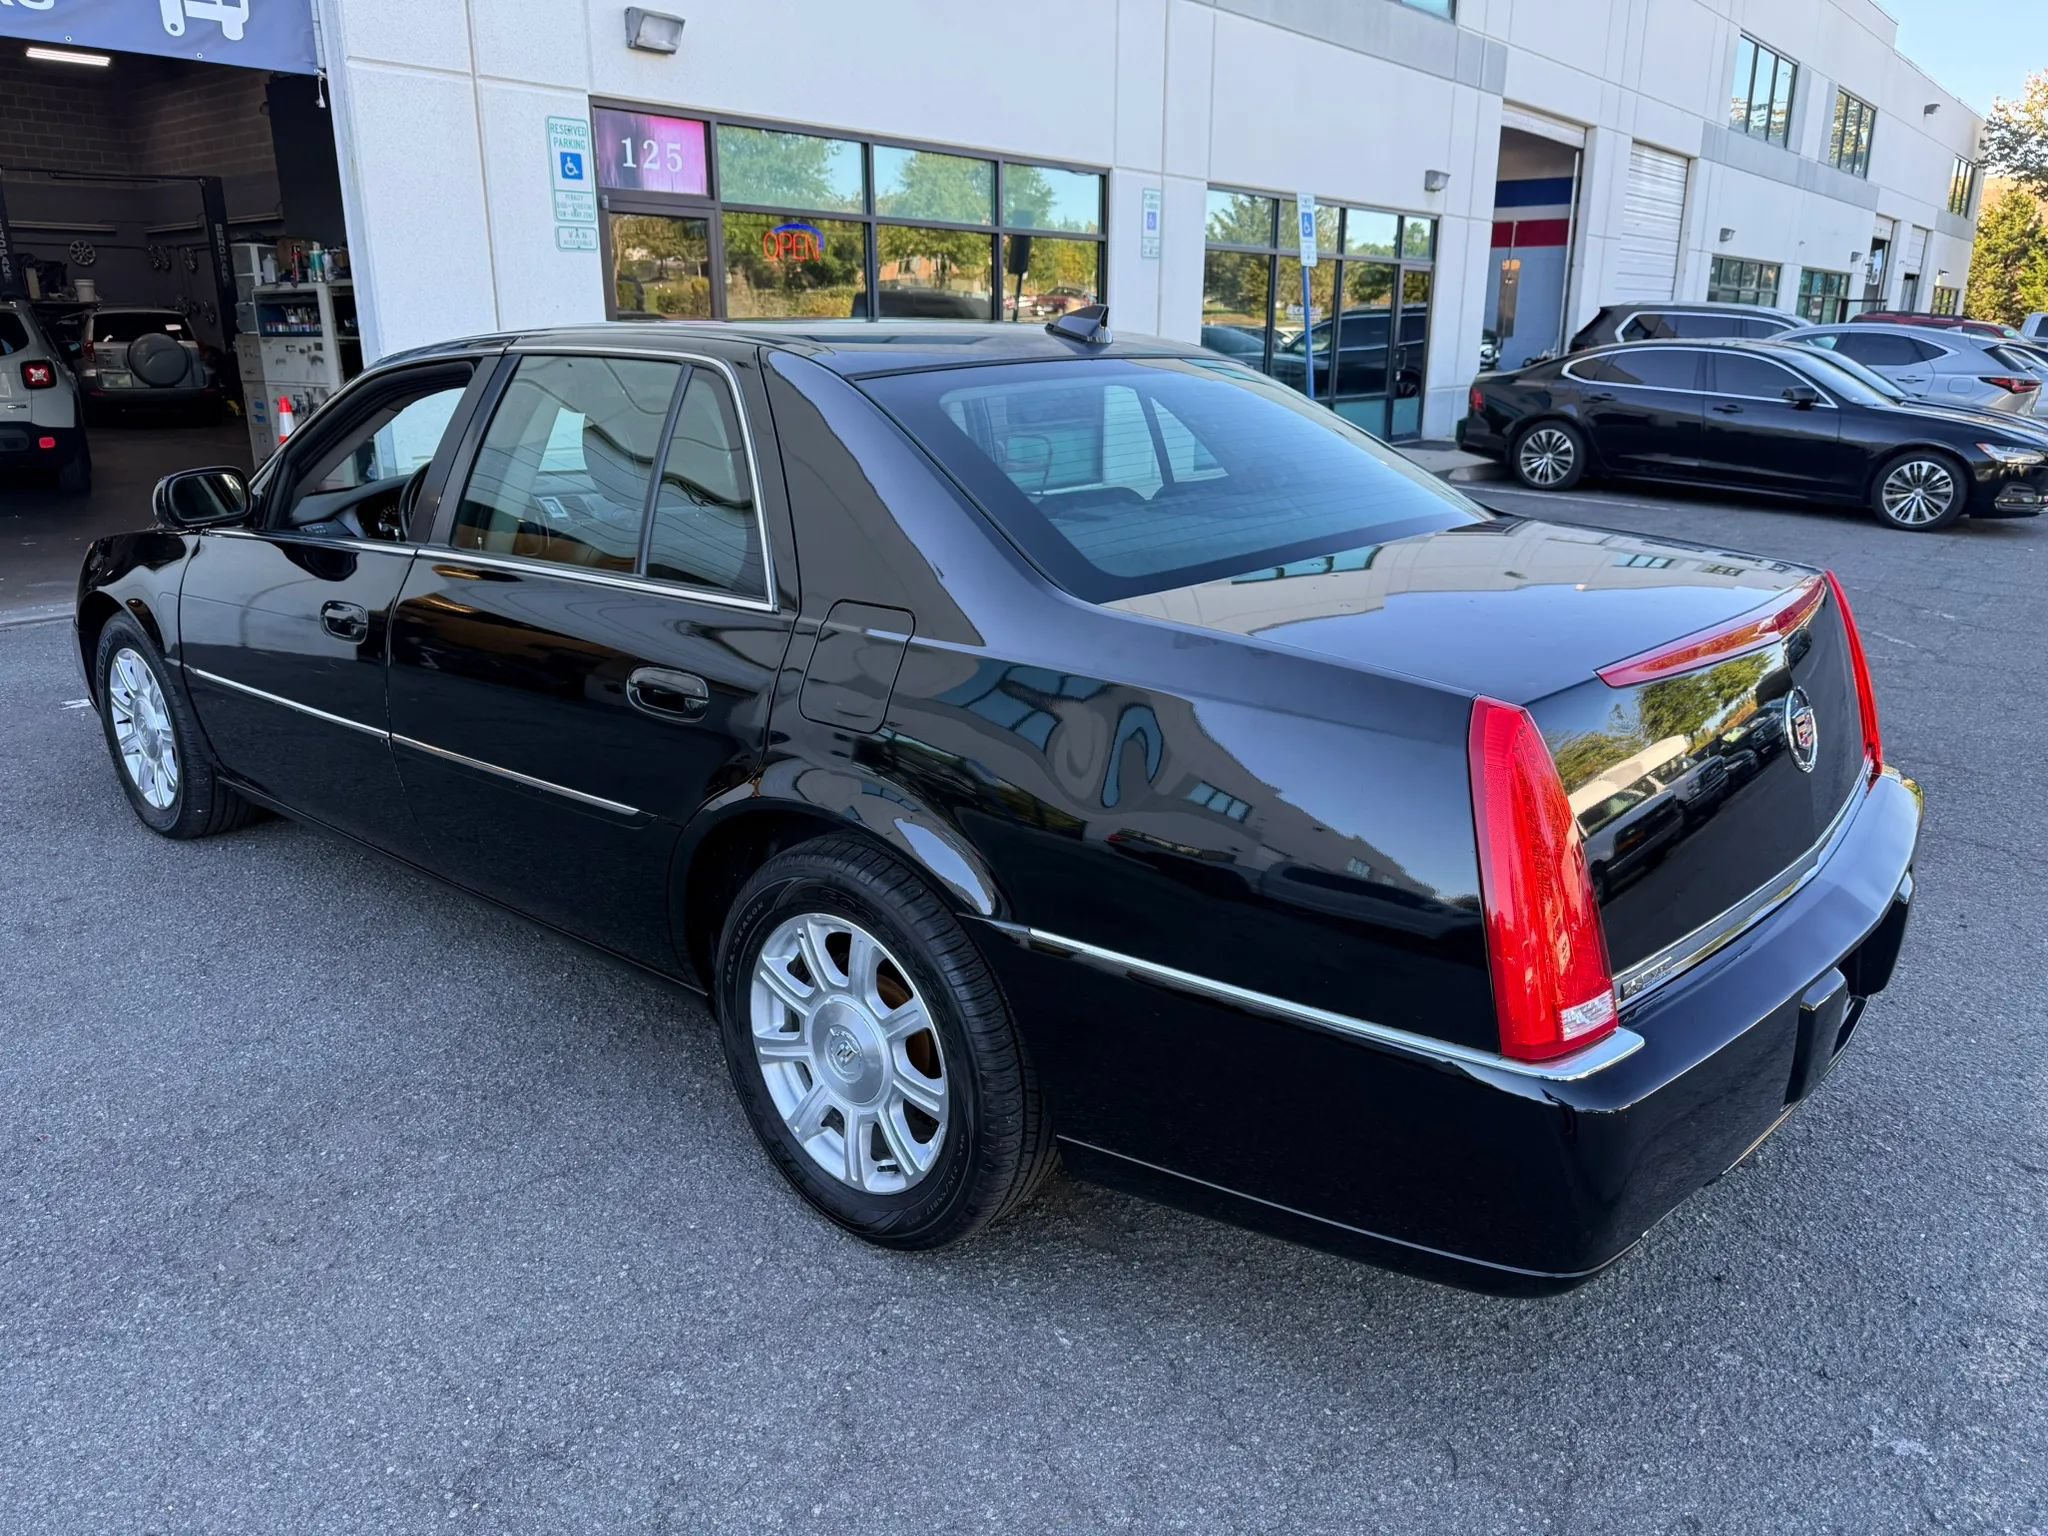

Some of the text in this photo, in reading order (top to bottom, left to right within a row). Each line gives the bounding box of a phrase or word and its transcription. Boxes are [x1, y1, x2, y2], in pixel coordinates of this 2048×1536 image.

[550, 123, 587, 137] RESERVED
[553, 137, 586, 150] PARKING
[621, 136, 683, 172] 125
[567, 230, 588, 240] VAN
[763, 231, 821, 262] OPEN
